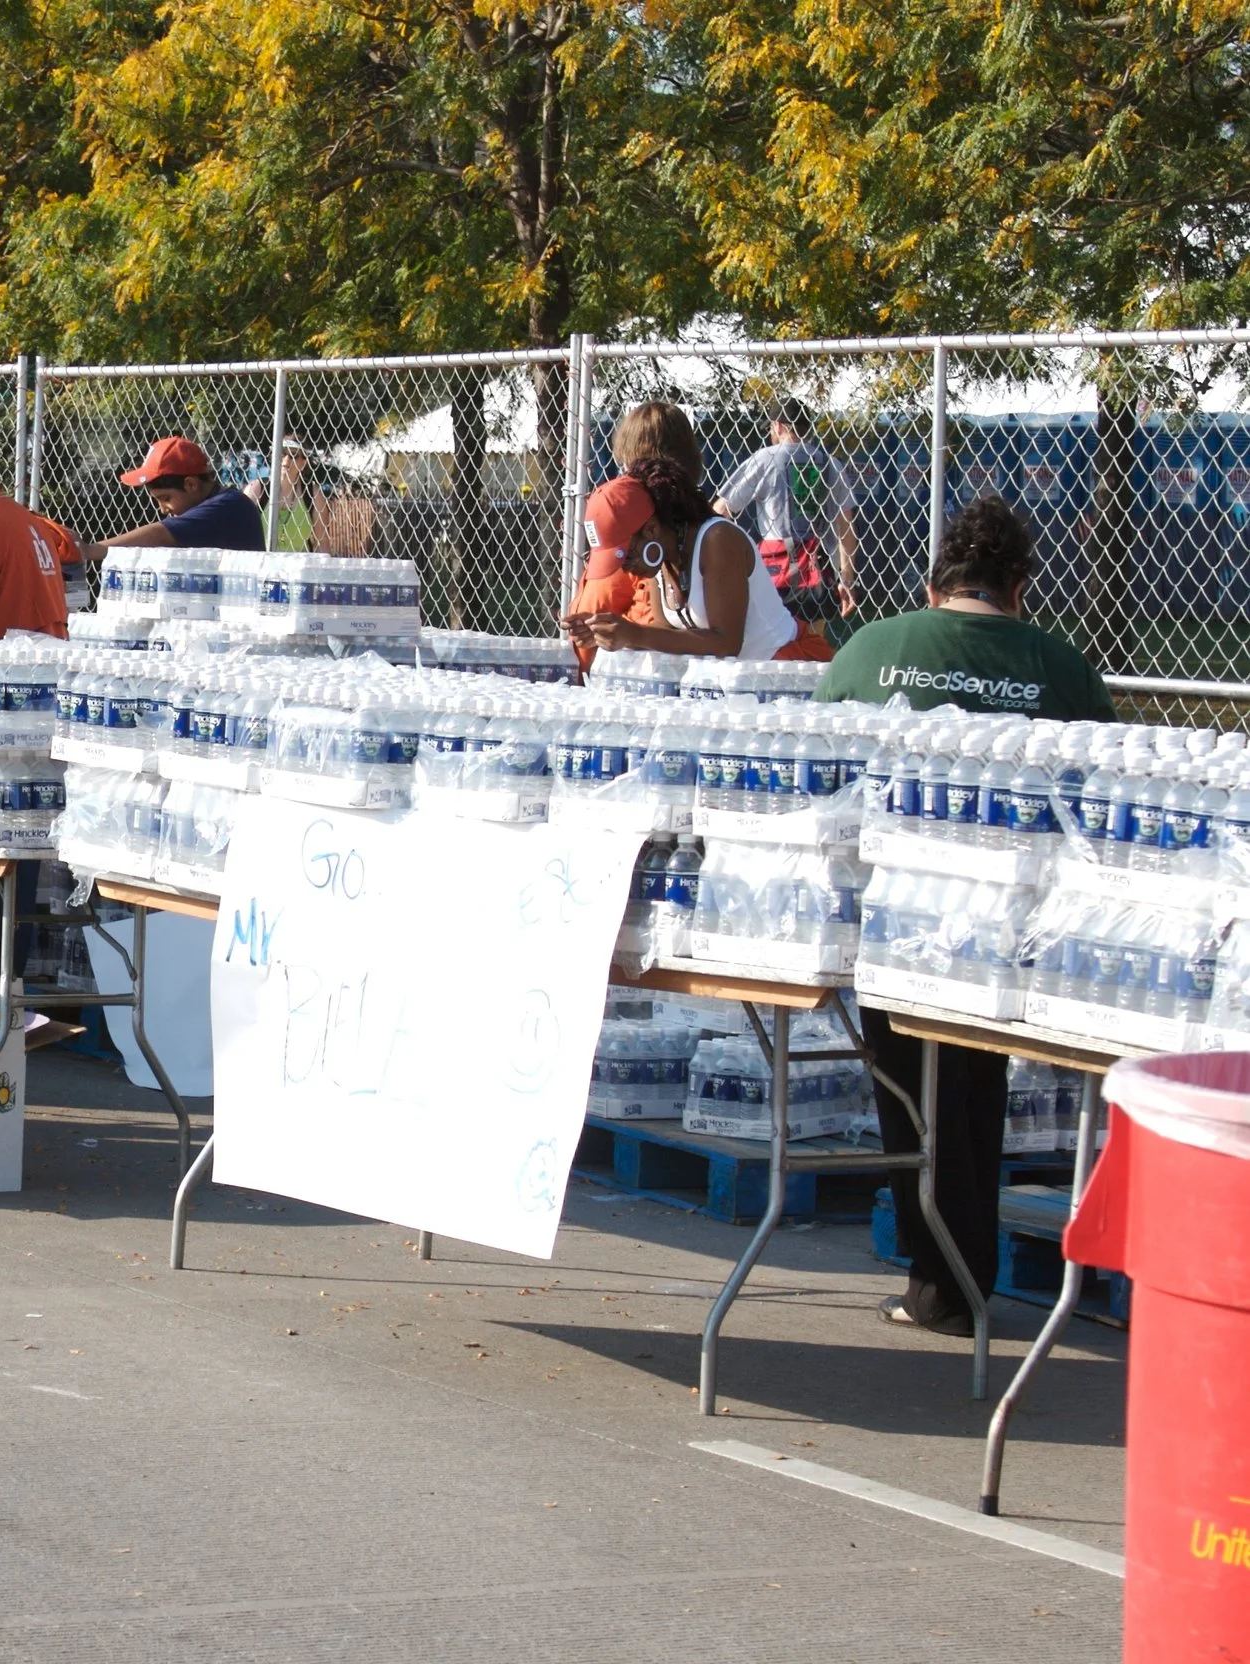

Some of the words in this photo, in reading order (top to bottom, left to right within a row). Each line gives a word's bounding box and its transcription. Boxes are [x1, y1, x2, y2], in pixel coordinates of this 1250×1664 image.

[112, 701, 137, 710] Hinckle
[980, 694, 1040, 710] Companies
[33, 785, 56, 793] Hinckle
[1011, 796, 1049, 811] Hinckley
[14, 829, 50, 839] Hinckley
[680, 878, 699, 887] Hinc
[709, 1119, 742, 1130] Hinckley
